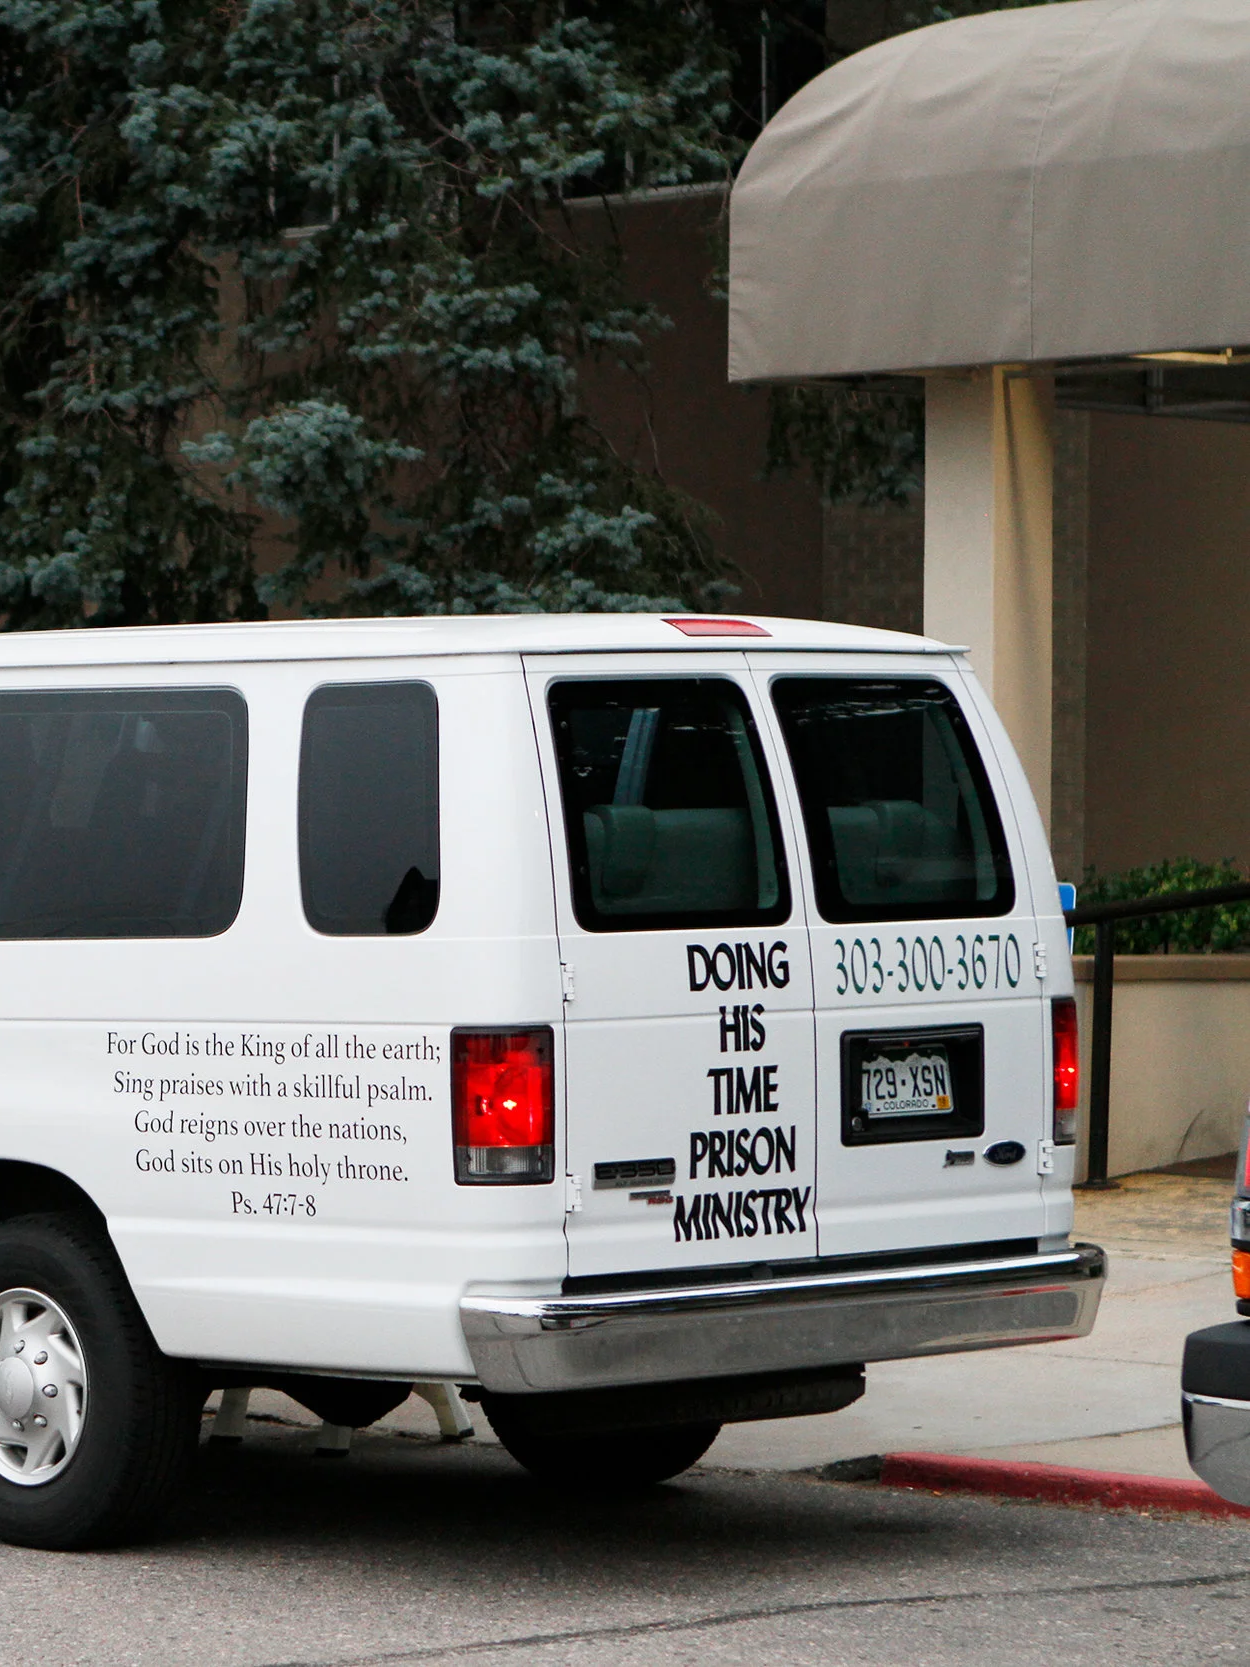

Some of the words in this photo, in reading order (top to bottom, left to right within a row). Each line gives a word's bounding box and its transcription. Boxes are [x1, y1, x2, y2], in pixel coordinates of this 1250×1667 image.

[686, 940, 791, 991] DOING
[834, 933, 1021, 995] 303-300-3670
[107, 1032, 137, 1054] For
[141, 1032, 179, 1055] God
[185, 1033, 200, 1056] is
[205, 1032, 235, 1056] the
[241, 1033, 286, 1065] King
[291, 1033, 313, 1058] of
[315, 1034, 339, 1058] all
[345, 1034, 376, 1059] the
[382, 1036, 441, 1064] earth;
[719, 1003, 766, 1052] HIS
[113, 1070, 154, 1101] Sing
[160, 1073, 224, 1102] praises
[229, 1073, 271, 1097] with
[277, 1081, 288, 1098] a
[293, 1074, 360, 1099] skillful
[367, 1076, 432, 1107] psalm.
[707, 1065, 780, 1115] TIME
[883, 1099, 929, 1110] COLORADO
[134, 1110, 174, 1133] God
[180, 1112, 238, 1142] reigns
[244, 1120, 286, 1138] over
[291, 1114, 323, 1138] the
[328, 1117, 408, 1145] nations,
[135, 1148, 176, 1172] God
[181, 1151, 213, 1174] sits
[218, 1157, 244, 1175] on
[250, 1152, 283, 1177] His
[288, 1153, 330, 1185] holy
[336, 1155, 409, 1182] throne.
[689, 1125, 796, 1179] PRISON
[231, 1191, 258, 1215] Ps.
[263, 1193, 317, 1217] 47:7-8
[673, 1186, 812, 1242] MINISTRY
